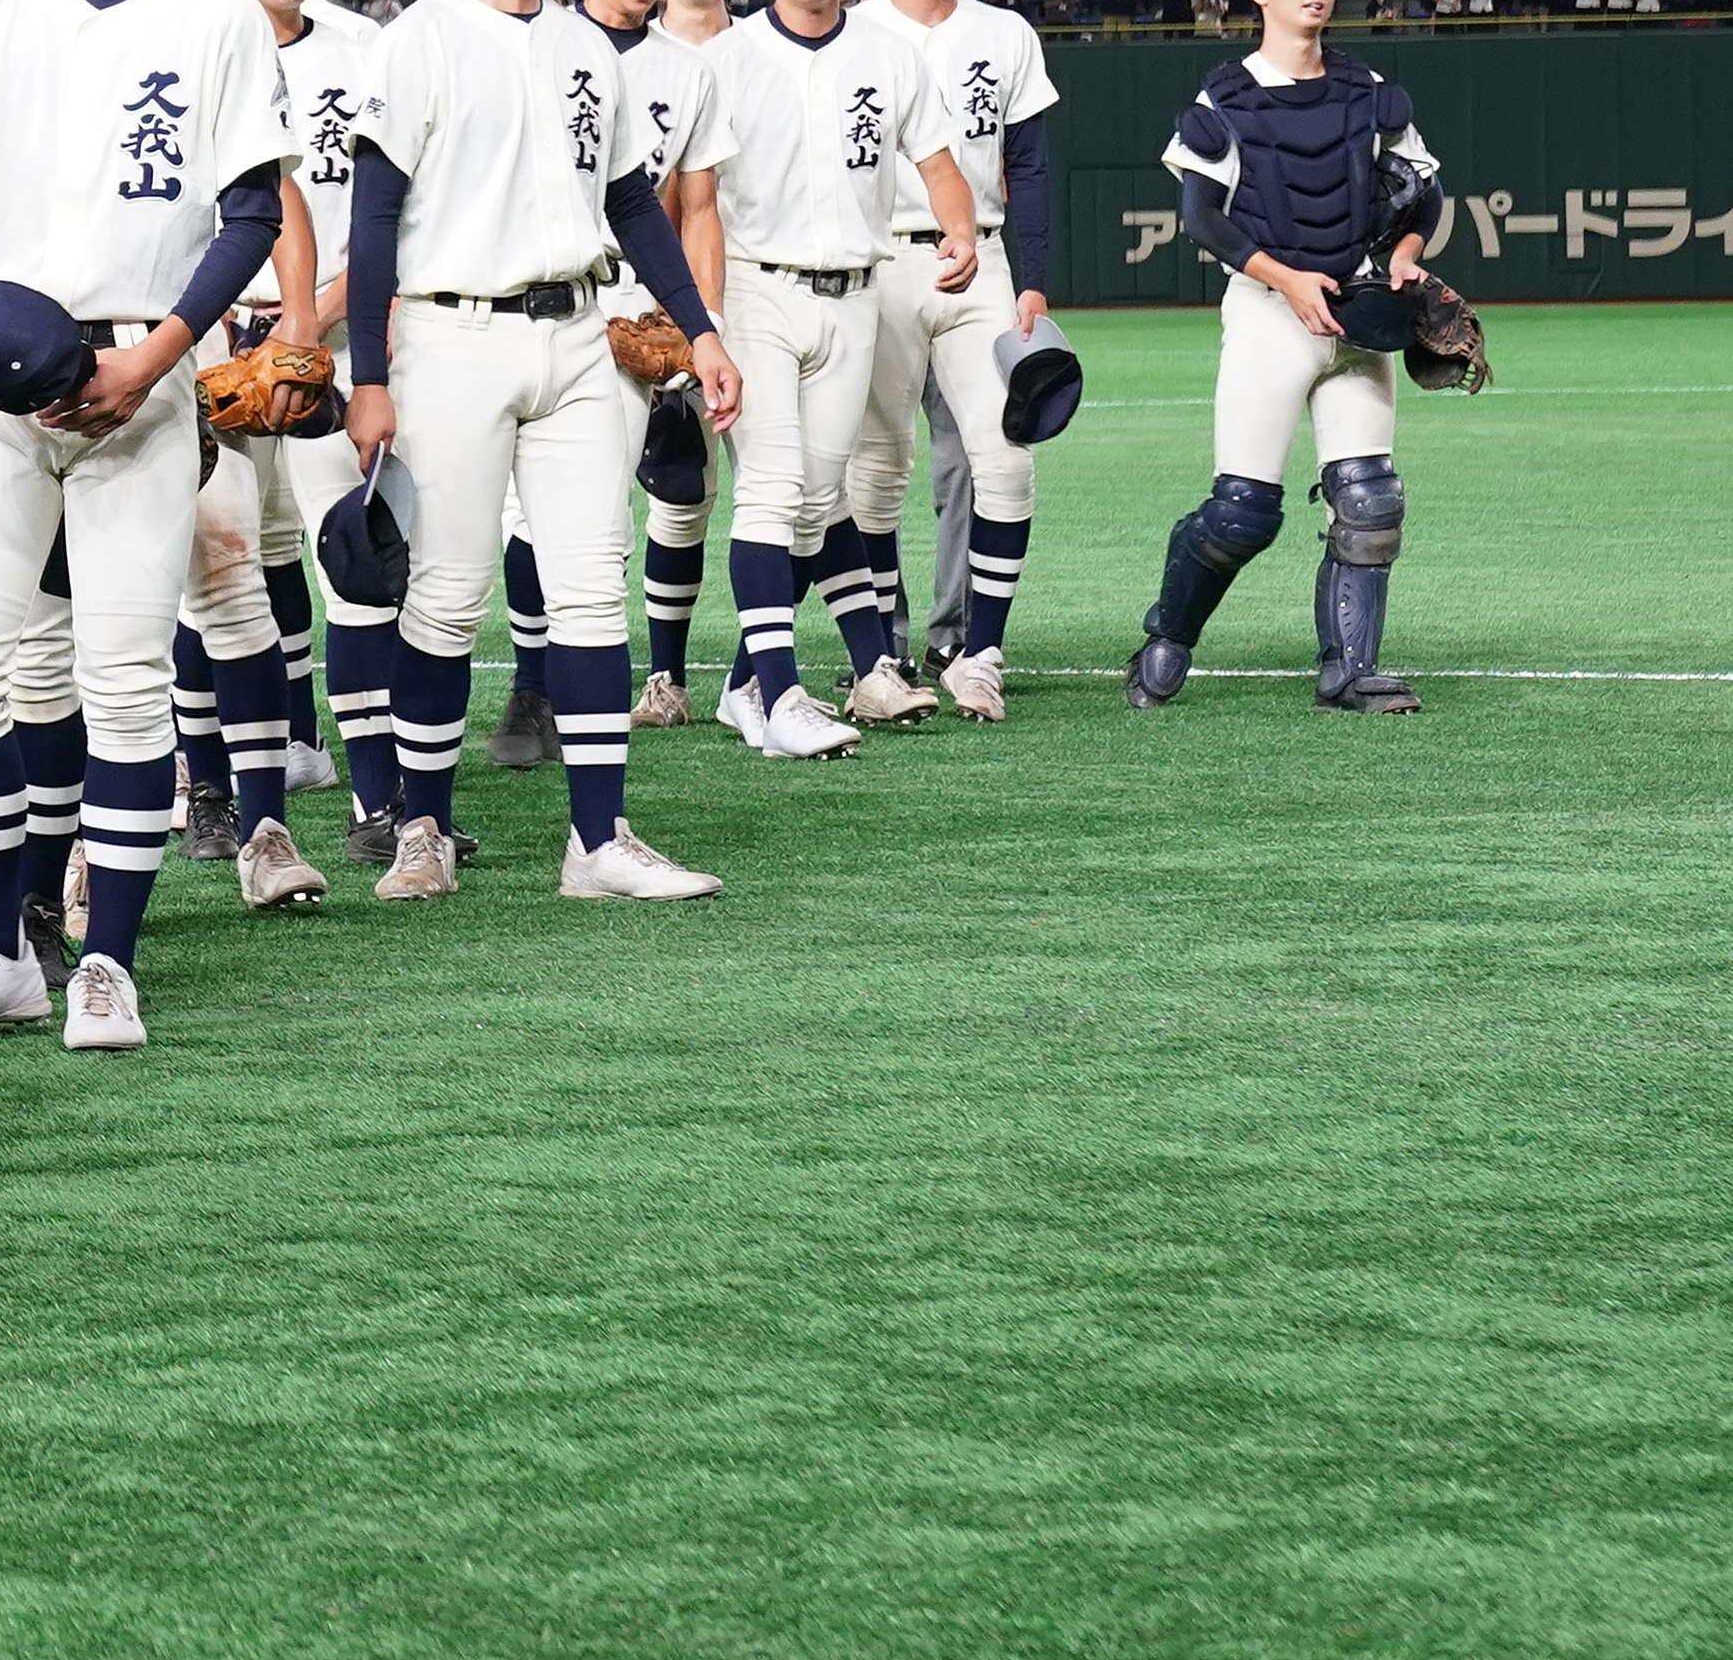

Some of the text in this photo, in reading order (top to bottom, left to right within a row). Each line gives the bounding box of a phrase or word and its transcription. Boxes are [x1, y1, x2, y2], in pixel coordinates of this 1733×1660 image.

[119, 71, 190, 202] 久我山
[308, 88, 358, 186] 久我山
[565, 69, 602, 174] 久我山
[845, 87, 885, 170] 久我山
[961, 59, 999, 140] 久我山
